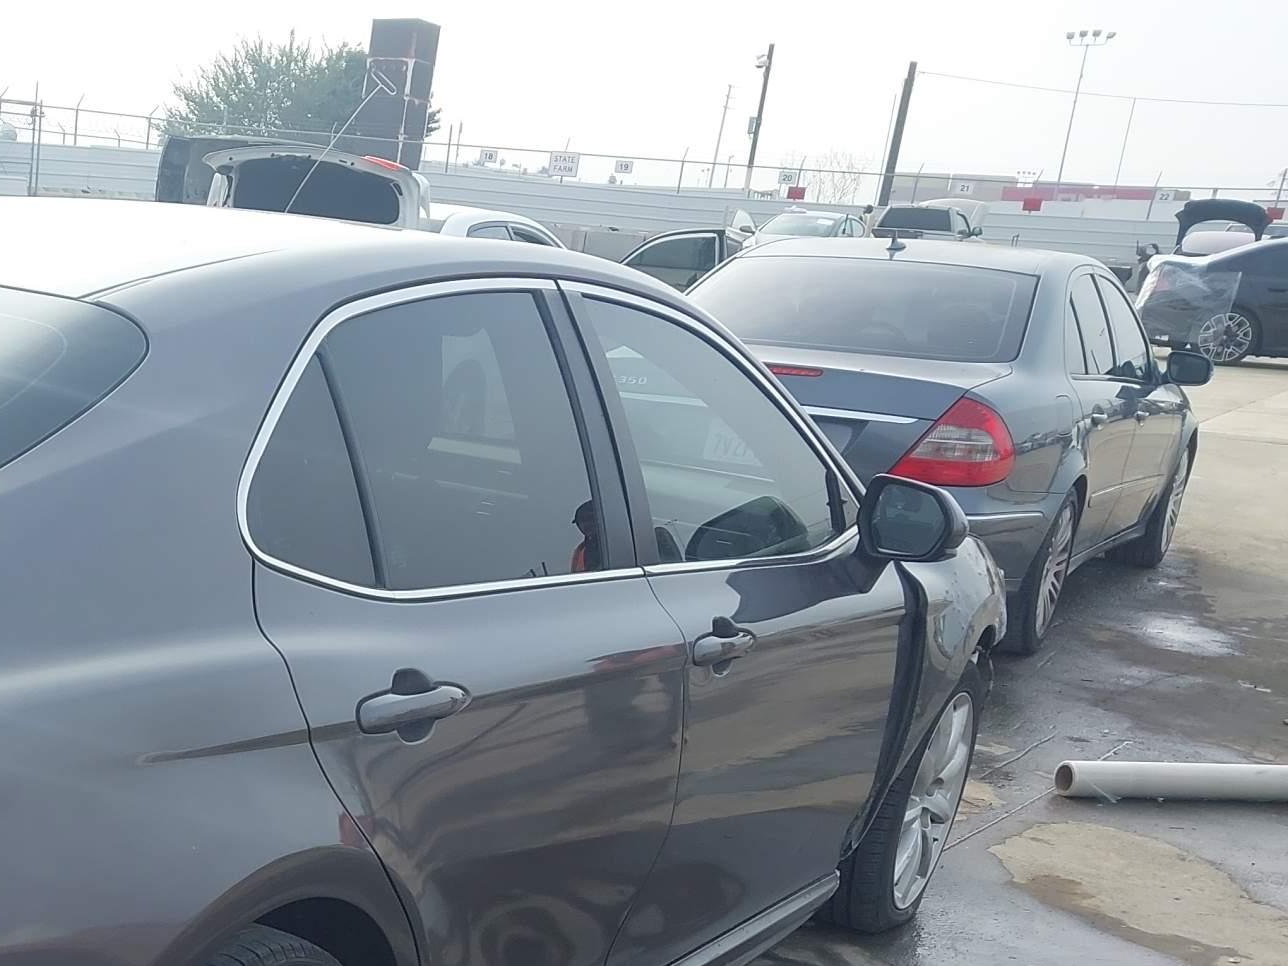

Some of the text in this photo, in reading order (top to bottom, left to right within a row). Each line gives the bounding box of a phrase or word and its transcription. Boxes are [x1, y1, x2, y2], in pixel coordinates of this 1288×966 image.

[484, 152, 493, 160] 18
[553, 156, 576, 164] STATE
[553, 165, 573, 173] FARM
[783, 174, 792, 182] 20
